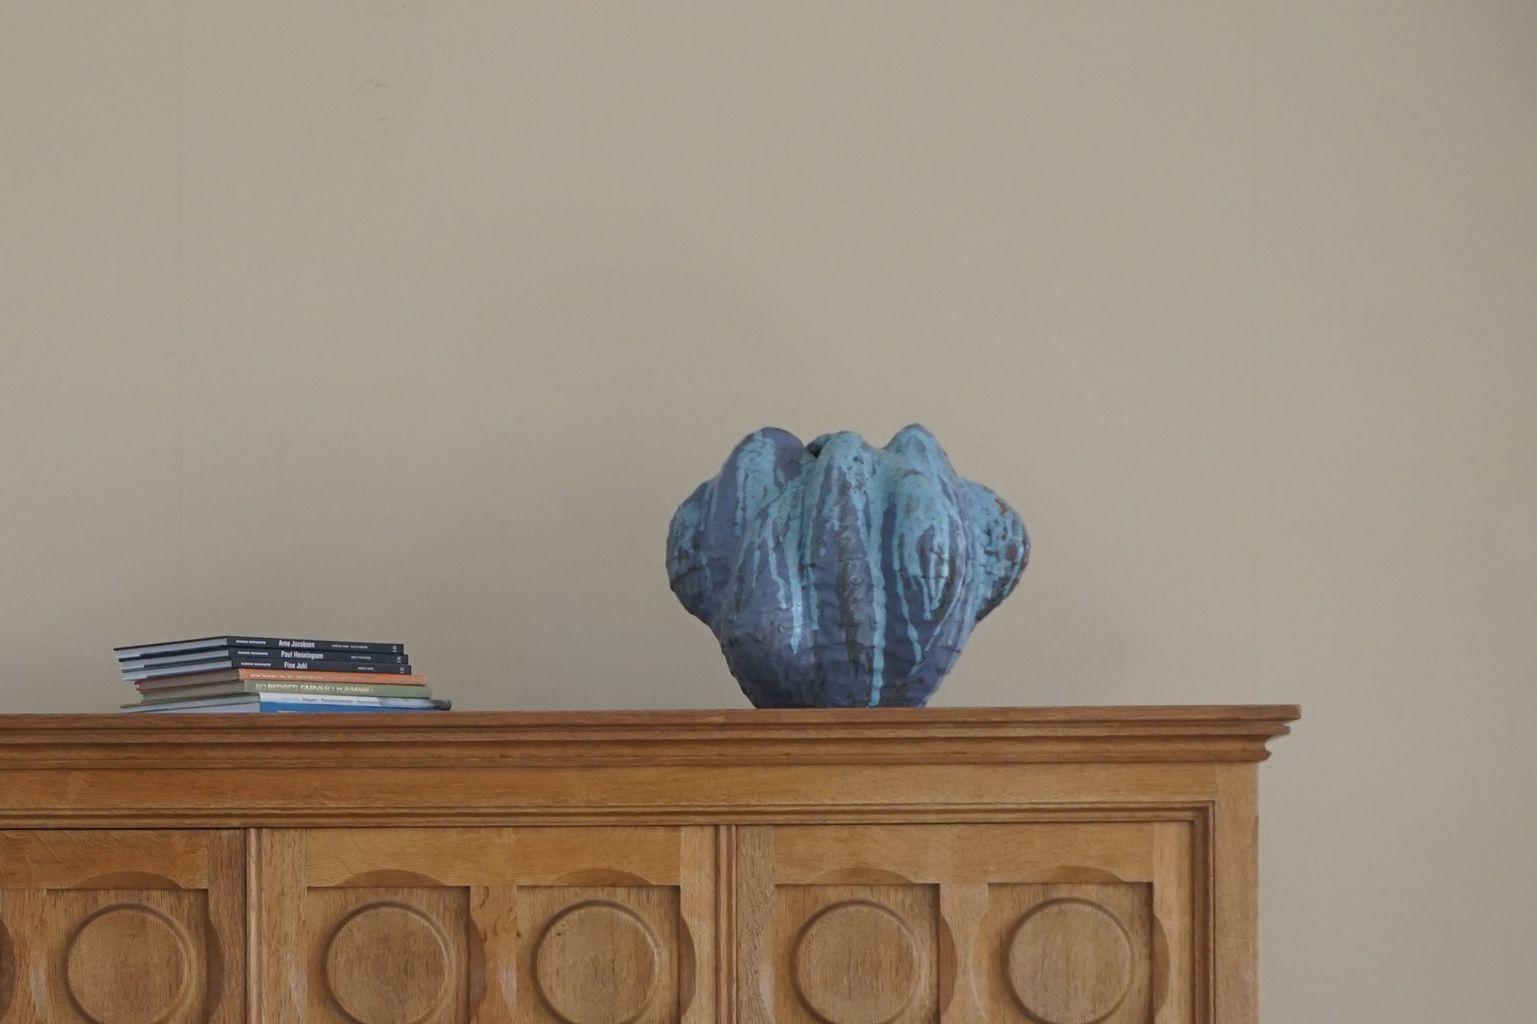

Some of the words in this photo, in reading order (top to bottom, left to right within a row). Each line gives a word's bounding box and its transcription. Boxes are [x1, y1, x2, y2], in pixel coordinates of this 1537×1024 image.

[291, 640, 315, 648] Jacobsen
[281, 650, 293, 658] Poul
[294, 651, 324, 660] Henningsen
[284, 661, 296, 669] Finn
